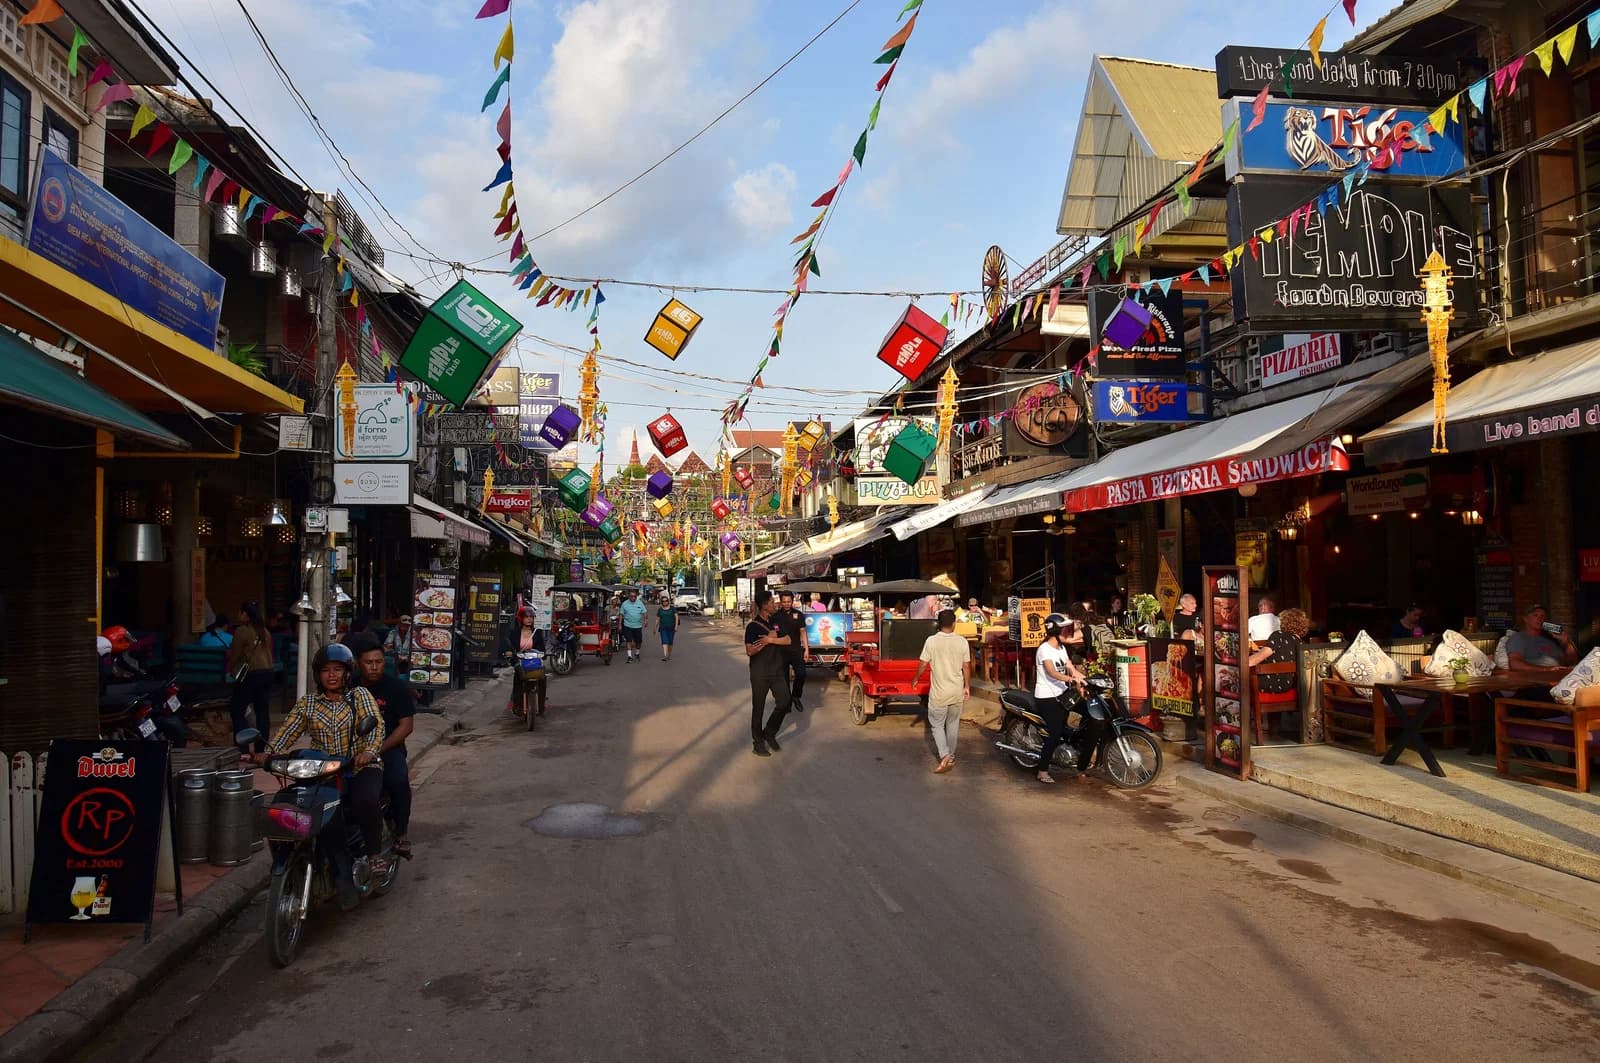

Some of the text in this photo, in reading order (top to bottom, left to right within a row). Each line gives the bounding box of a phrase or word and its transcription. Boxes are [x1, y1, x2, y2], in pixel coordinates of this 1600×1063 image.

[1239, 55, 1274, 81] Live
[1321, 55, 1358, 88] daily
[1363, 58, 1400, 86] from
[1321, 106, 1435, 170] Tiger
[1254, 190, 1476, 279] TEMPLE
[455, 295, 493, 334] 16
[1147, 302, 1175, 340] Ristorante
[428, 336, 461, 382] TEMPLE
[896, 336, 924, 369] TEMPLE
[1262, 335, 1340, 378] PIZZERIA
[1299, 360, 1341, 377] RISTORANTE
[485, 381, 513, 392] ASS
[1127, 384, 1177, 412] Tiger
[1484, 405, 1600, 441] Live band d
[1229, 441, 1333, 482] SANDWICH
[488, 496, 530, 508] Angkor
[859, 480, 938, 500] PIZZERIA
[1107, 465, 1222, 504] PASTA PIZZERIA
[78, 756, 136, 778] Duvel
